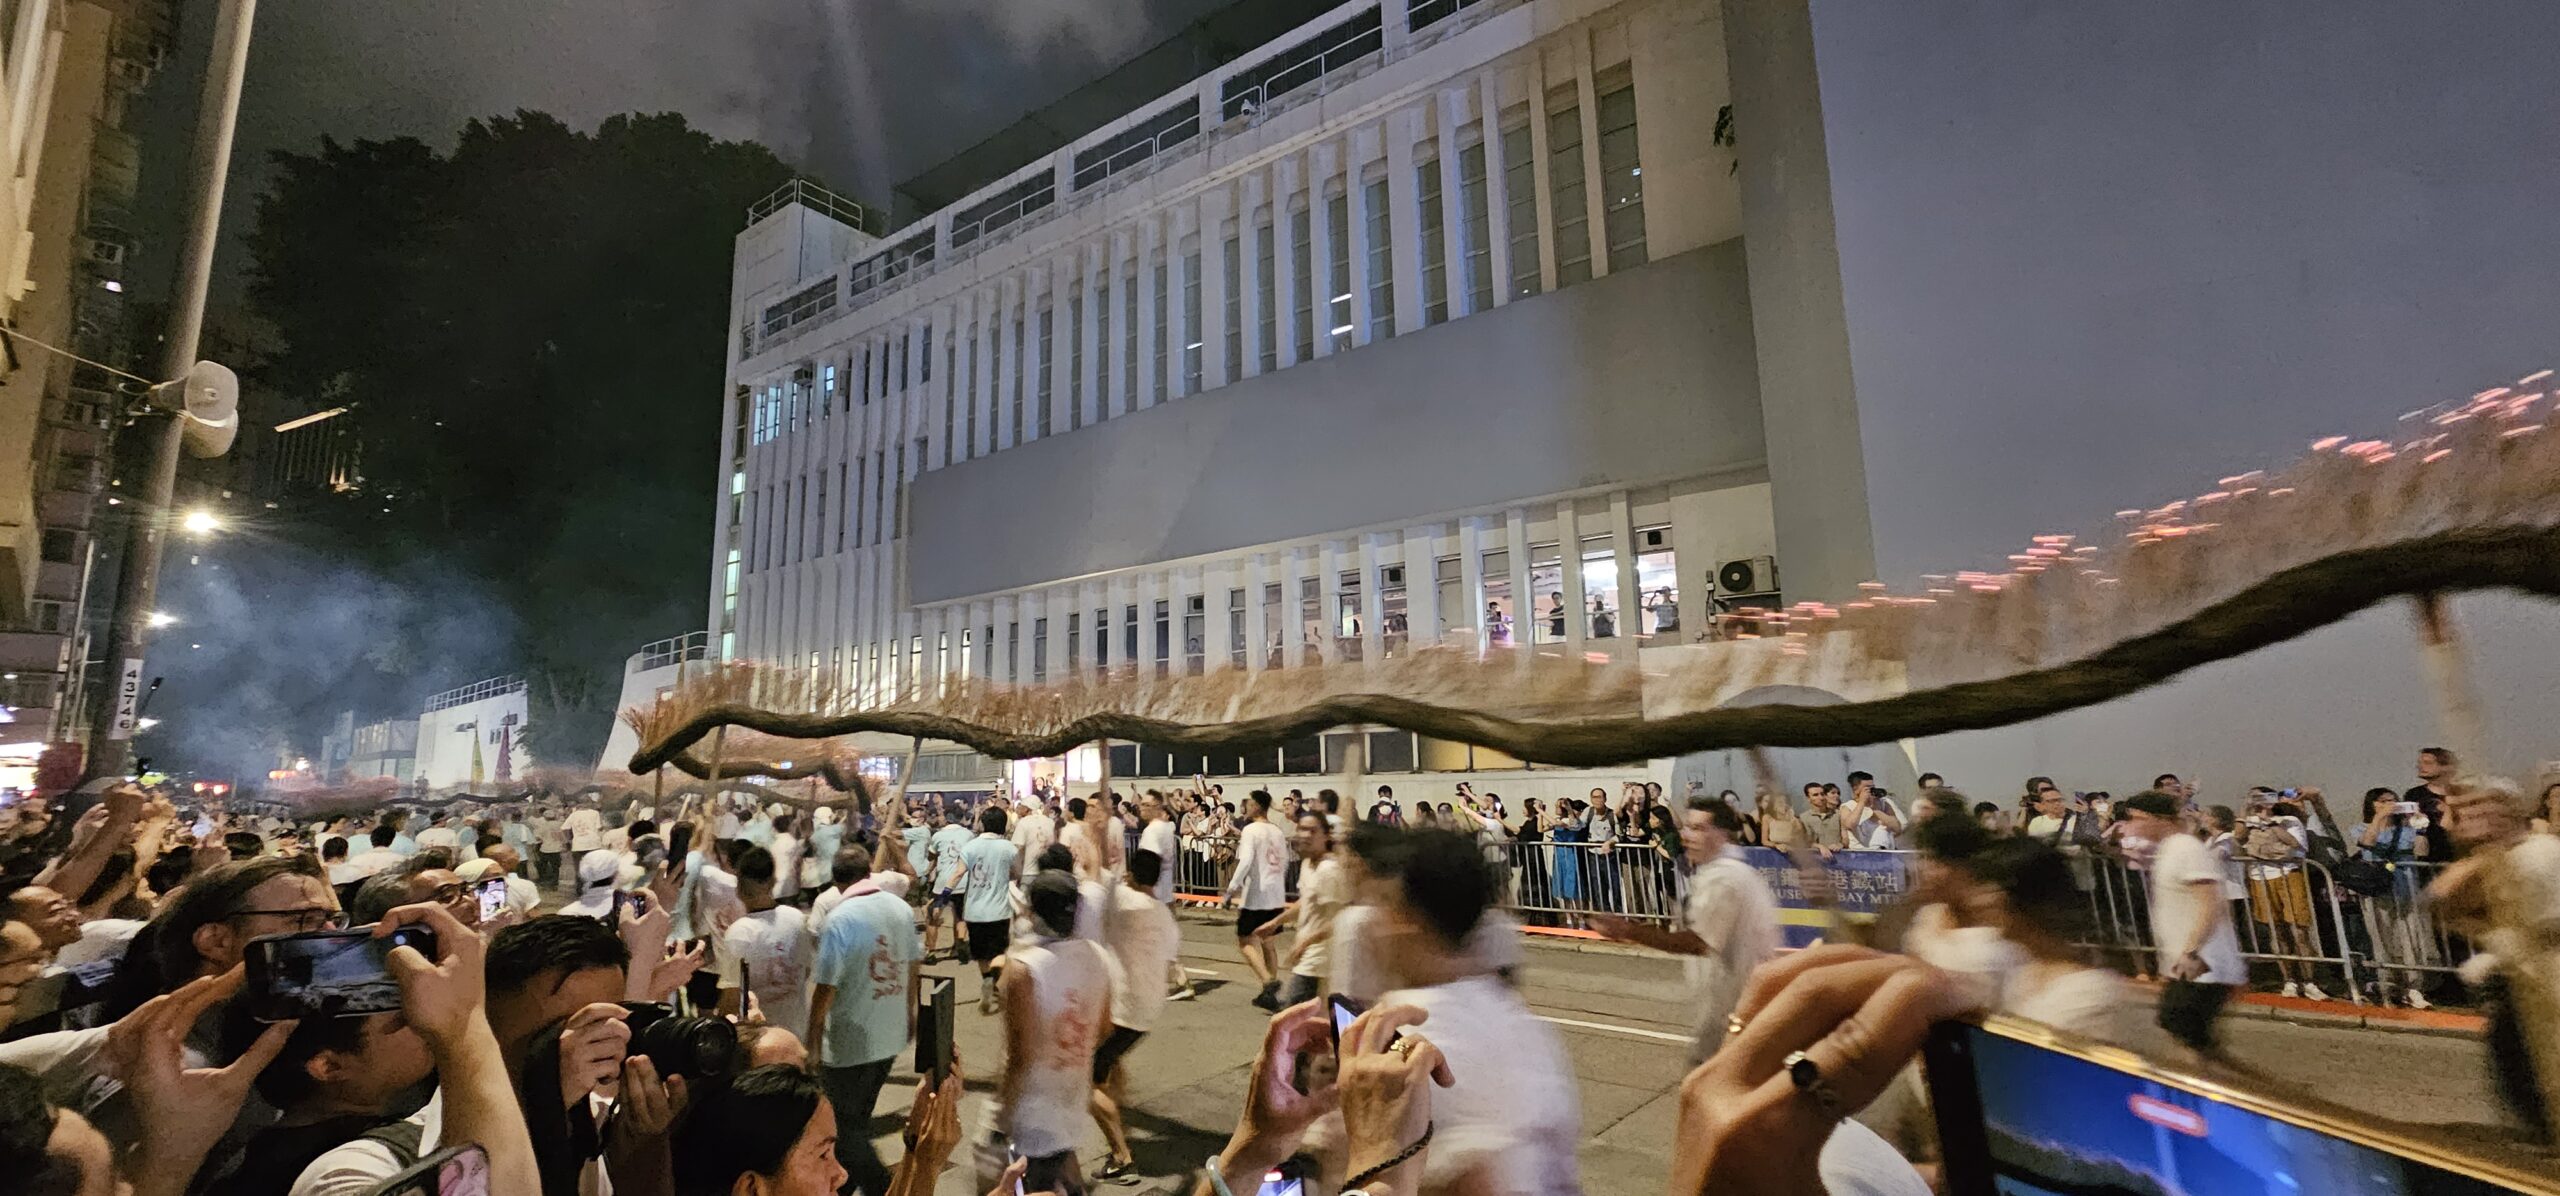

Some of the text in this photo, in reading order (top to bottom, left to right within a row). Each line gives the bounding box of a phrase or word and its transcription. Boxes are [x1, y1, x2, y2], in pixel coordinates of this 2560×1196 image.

[119, 670, 137, 729] 43746
[1758, 867, 1898, 892] 銅鑼港鐵站
[1838, 892, 1865, 903] BAY
